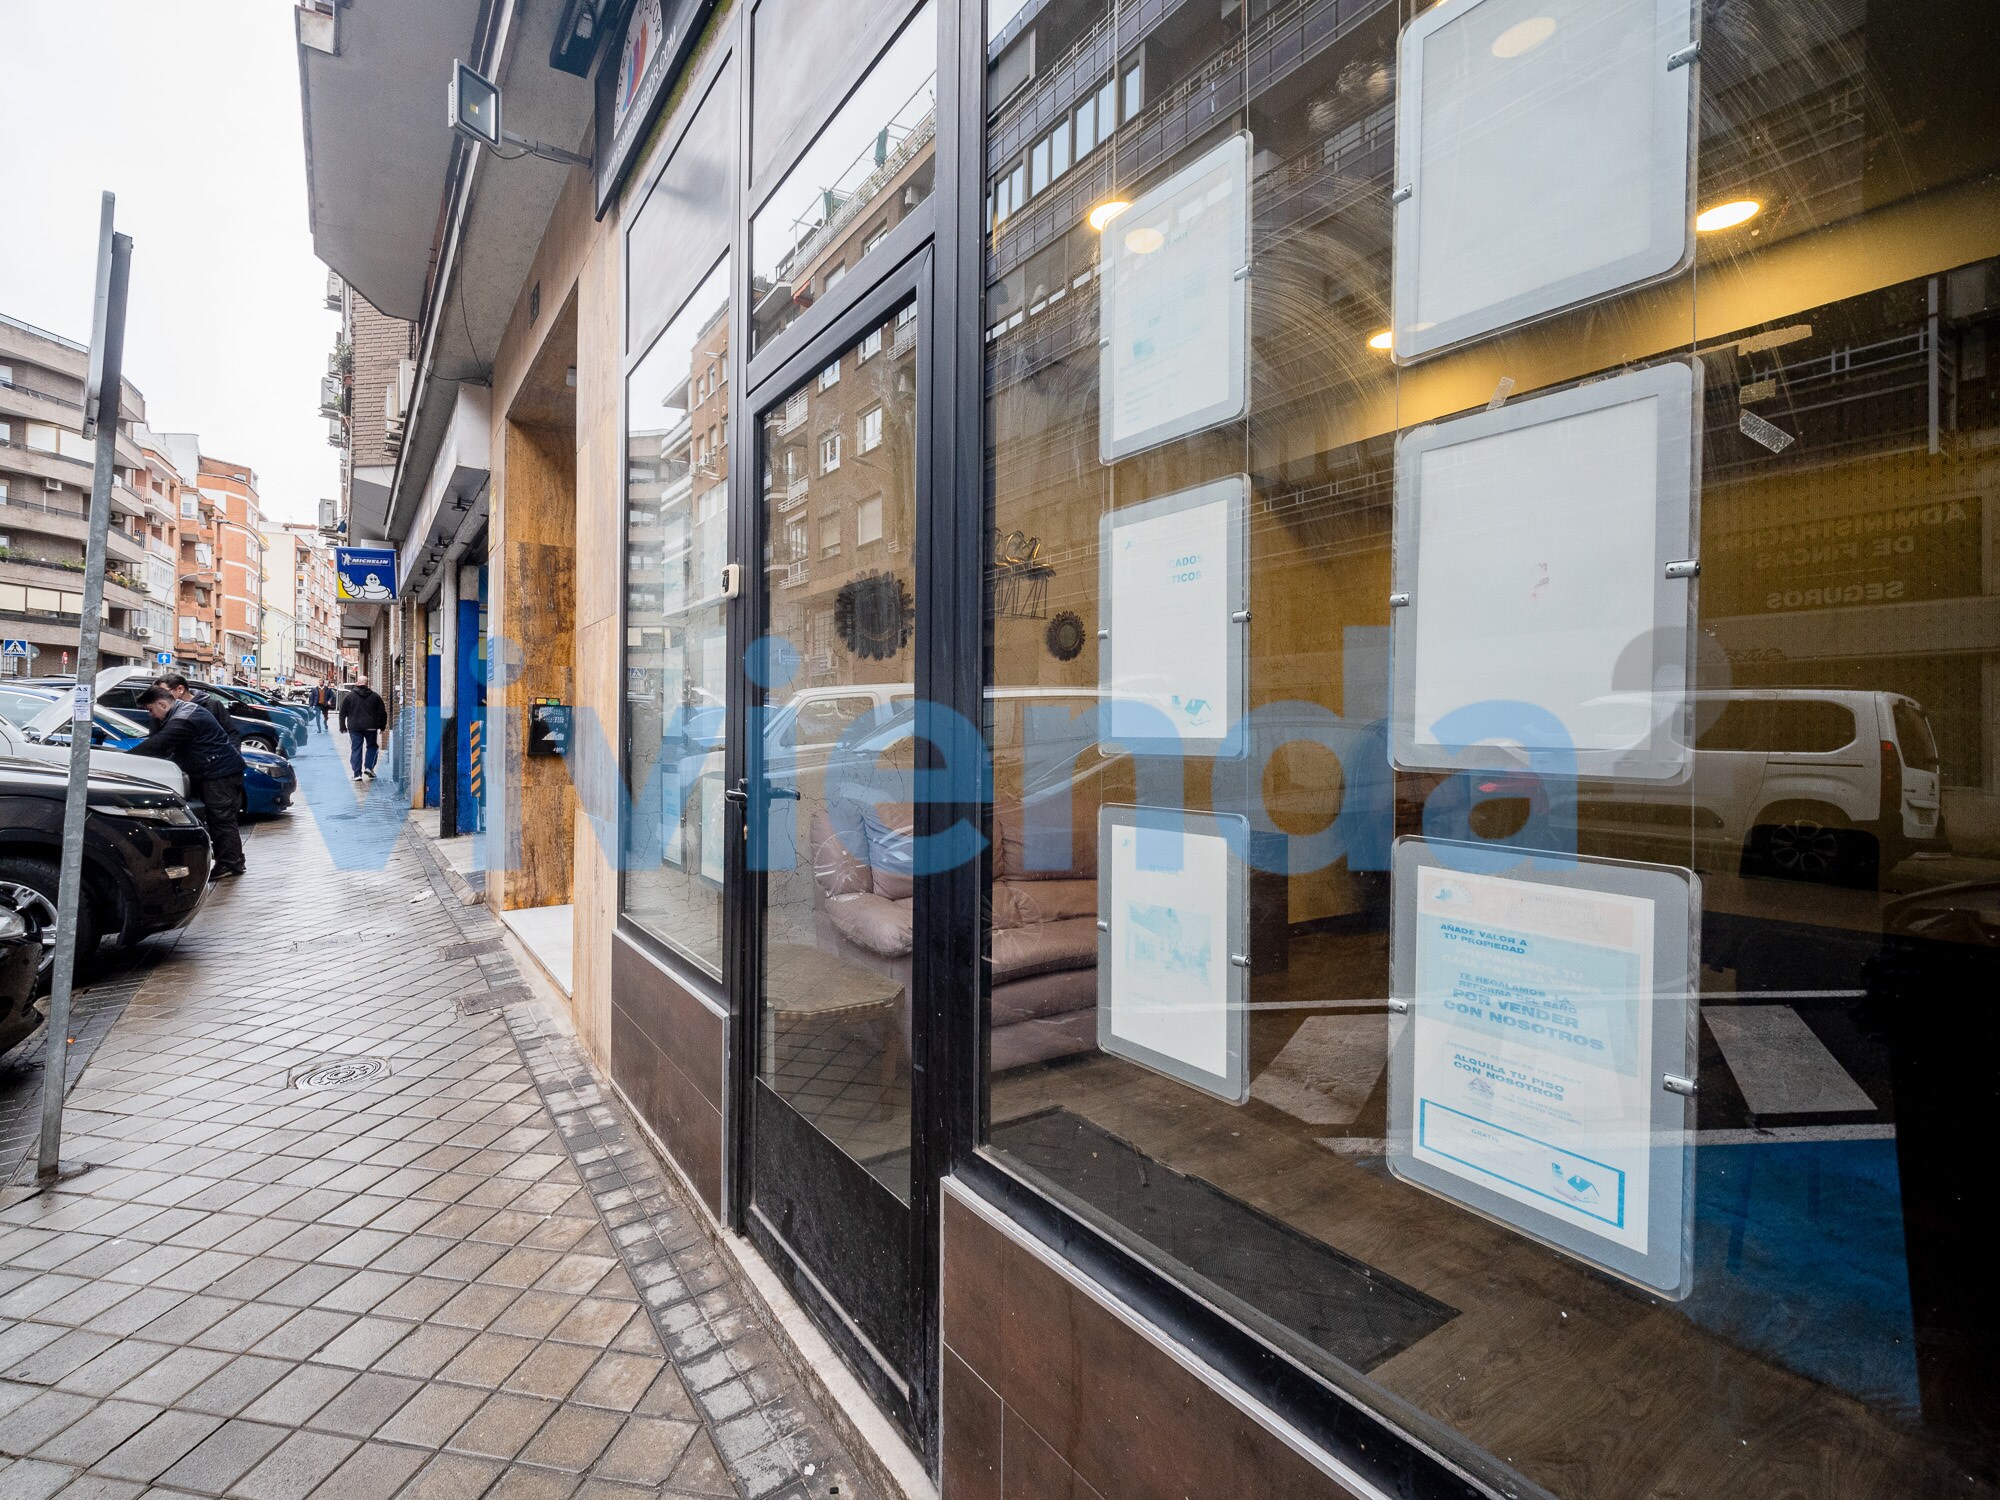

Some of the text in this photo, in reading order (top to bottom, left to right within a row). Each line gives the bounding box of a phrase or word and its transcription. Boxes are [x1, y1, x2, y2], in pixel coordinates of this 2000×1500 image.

[1440, 922, 1476, 936] AÑADE
[1479, 930, 1515, 944] VALOR
[1444, 932, 1525, 955] TU PROPIEDAD
[1458, 979, 1576, 1014] REFORMA DEL BAÑO
[1459, 971, 1471, 980] TE
[1475, 975, 1545, 998] REGALAMOS
[1443, 999, 1604, 1052] CON NOSOTROS
[1452, 987, 1578, 1029] POR VENDER
[1453, 1060, 1563, 1102] CON NOSOTROS
[1454, 1052, 1564, 1093] ALQUILA TU PISO
